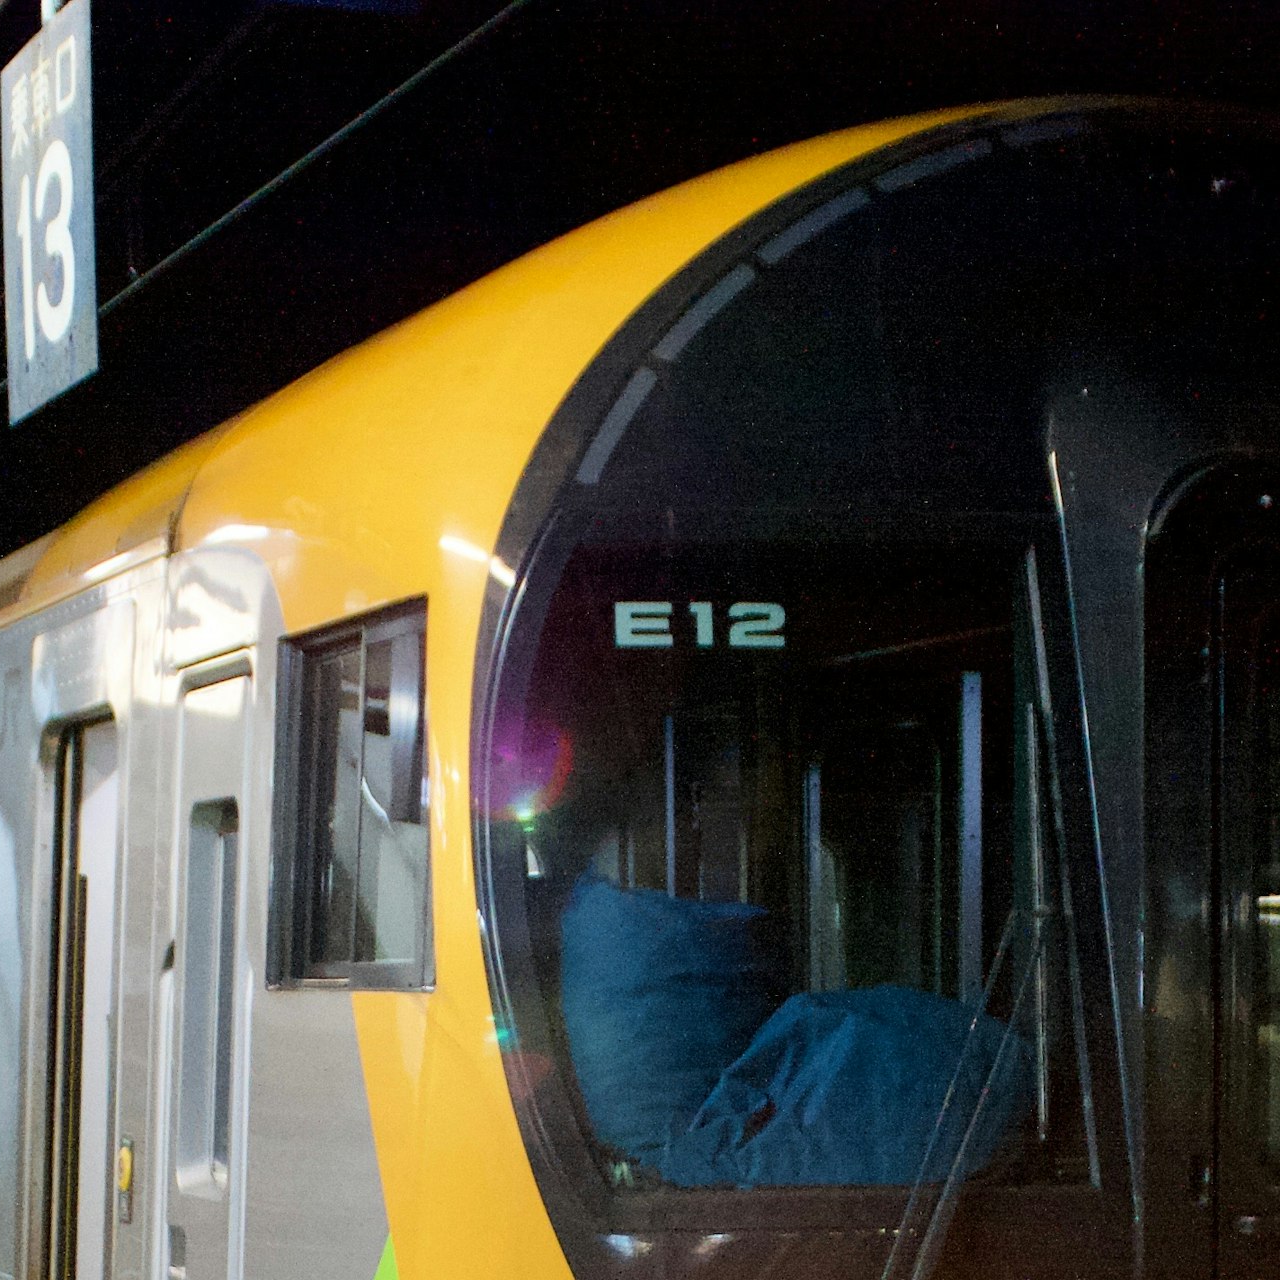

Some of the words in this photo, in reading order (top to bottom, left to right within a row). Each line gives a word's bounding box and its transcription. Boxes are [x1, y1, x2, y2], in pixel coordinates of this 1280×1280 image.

[10, 35, 77, 158] 乗車口
[17, 140, 75, 360] 13
[614, 601, 786, 648] E12
